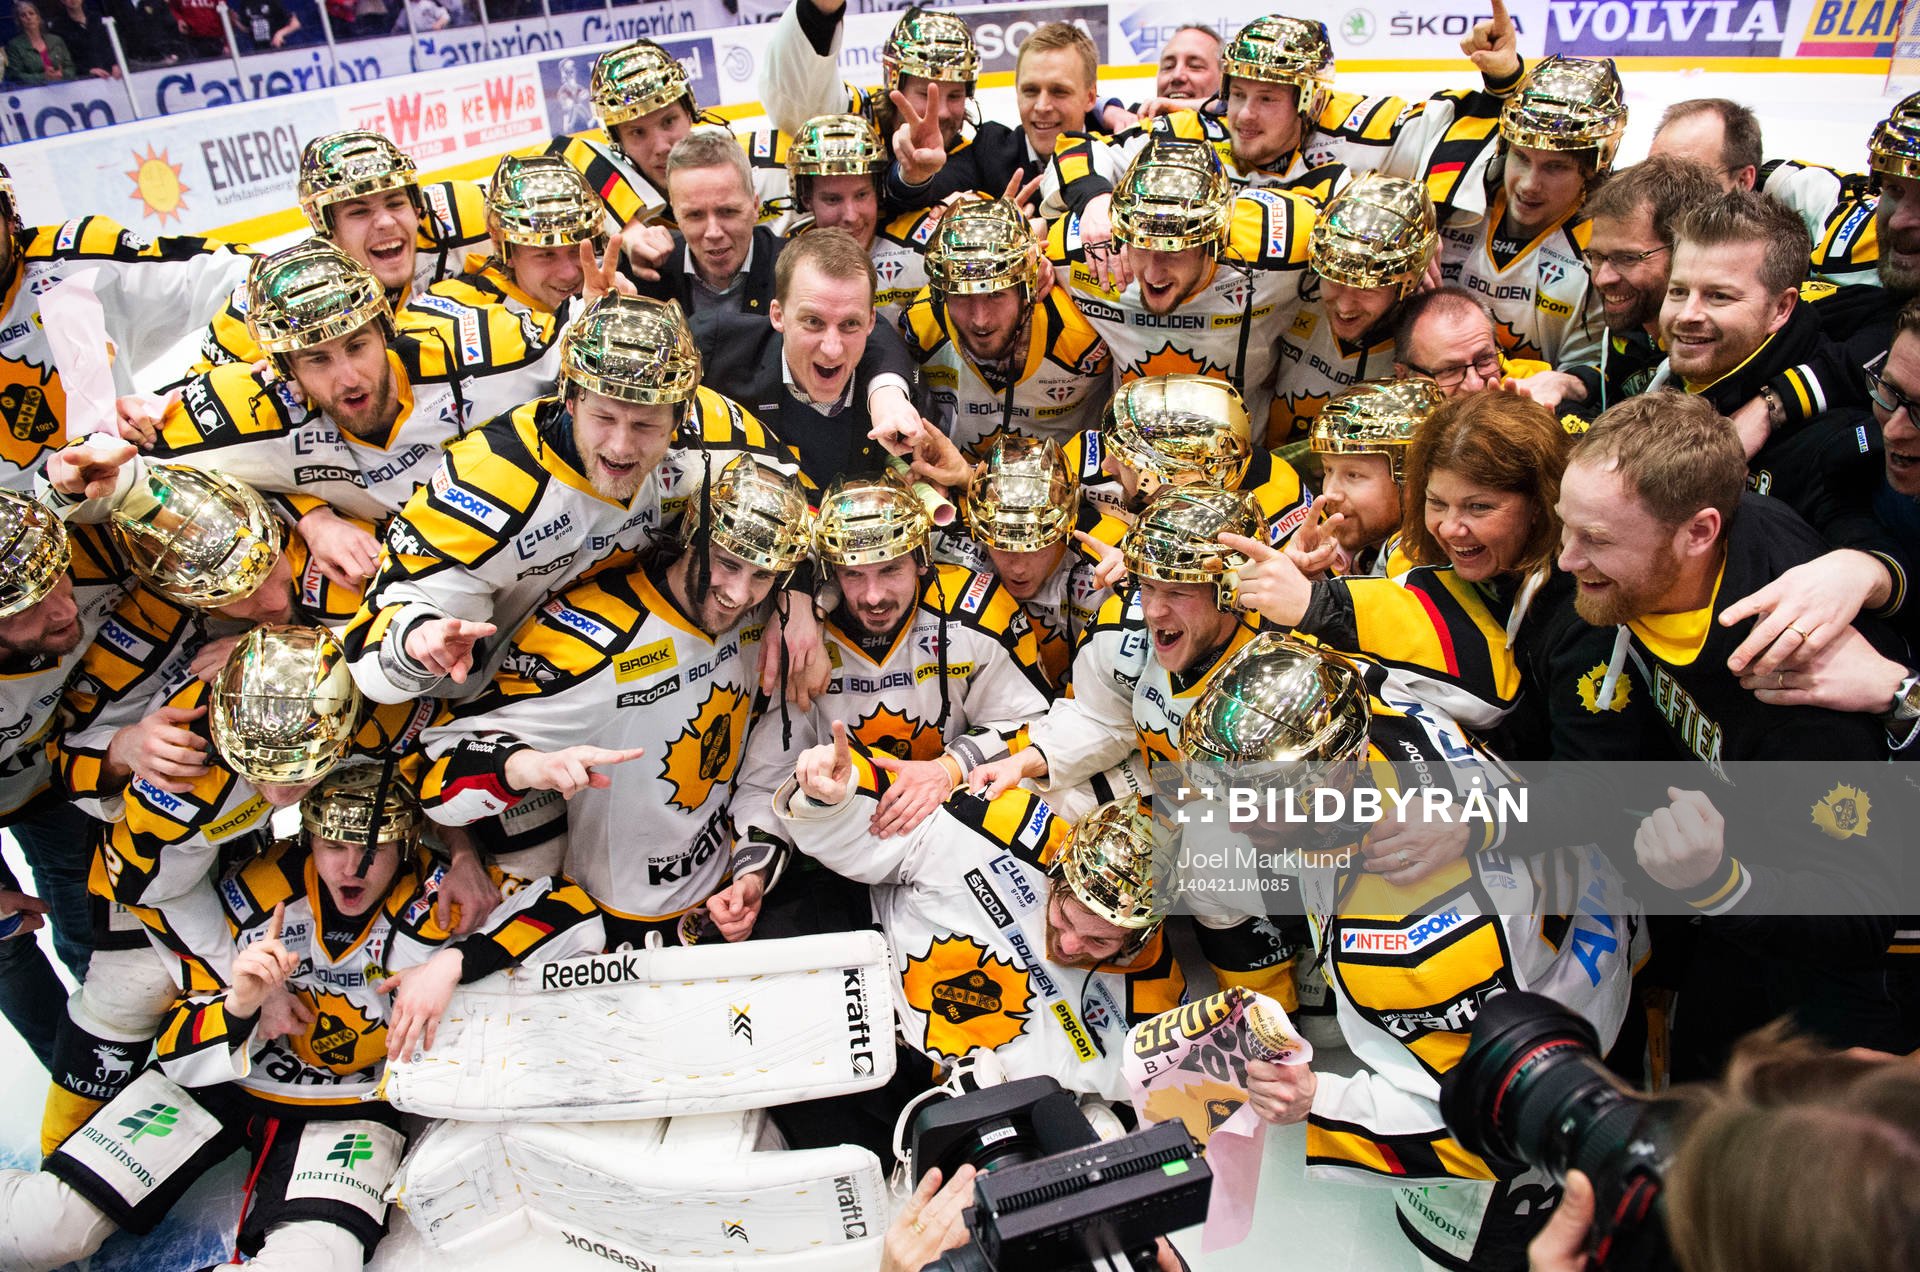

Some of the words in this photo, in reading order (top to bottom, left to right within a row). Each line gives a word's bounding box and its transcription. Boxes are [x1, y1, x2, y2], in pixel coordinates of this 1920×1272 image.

[1390, 11, 1524, 36] ŠKOA
[1549, 1, 1785, 42] VOLVIA
[0, 96, 116, 141] ion
[1491, 239, 1520, 255] SHL
[1467, 274, 1532, 302] BOLIDEN
[1136, 313, 1206, 330] BOLIDEN
[969, 403, 1030, 418] BOLIEN
[300, 467, 367, 488] ŠKODA
[444, 487, 493, 520] SPORT
[968, 571, 991, 599] INTER
[101, 620, 138, 650] PORT
[558, 610, 602, 637] SPORT
[861, 637, 891, 648] SHL
[620, 648, 670, 673] BROKK
[621, 680, 679, 706] ŠKODA
[851, 673, 913, 692] BOLIDEN
[140, 779, 183, 812] SPORT
[210, 801, 266, 836] BROKK
[1029, 803, 1049, 837] SPORT
[223, 879, 246, 911] SPORT
[970, 873, 1007, 926] ŠKODA
[324, 931, 356, 944] SHL
[1357, 934, 1407, 952] INTER
[1408, 906, 1462, 947] SPORT
[543, 953, 640, 990] Reebok
[1009, 934, 1057, 998] BOLIDEN
[1056, 1003, 1093, 1058] engcon
[82, 1126, 157, 1188] martinsons
[1400, 1187, 1467, 1242] rtinsons
